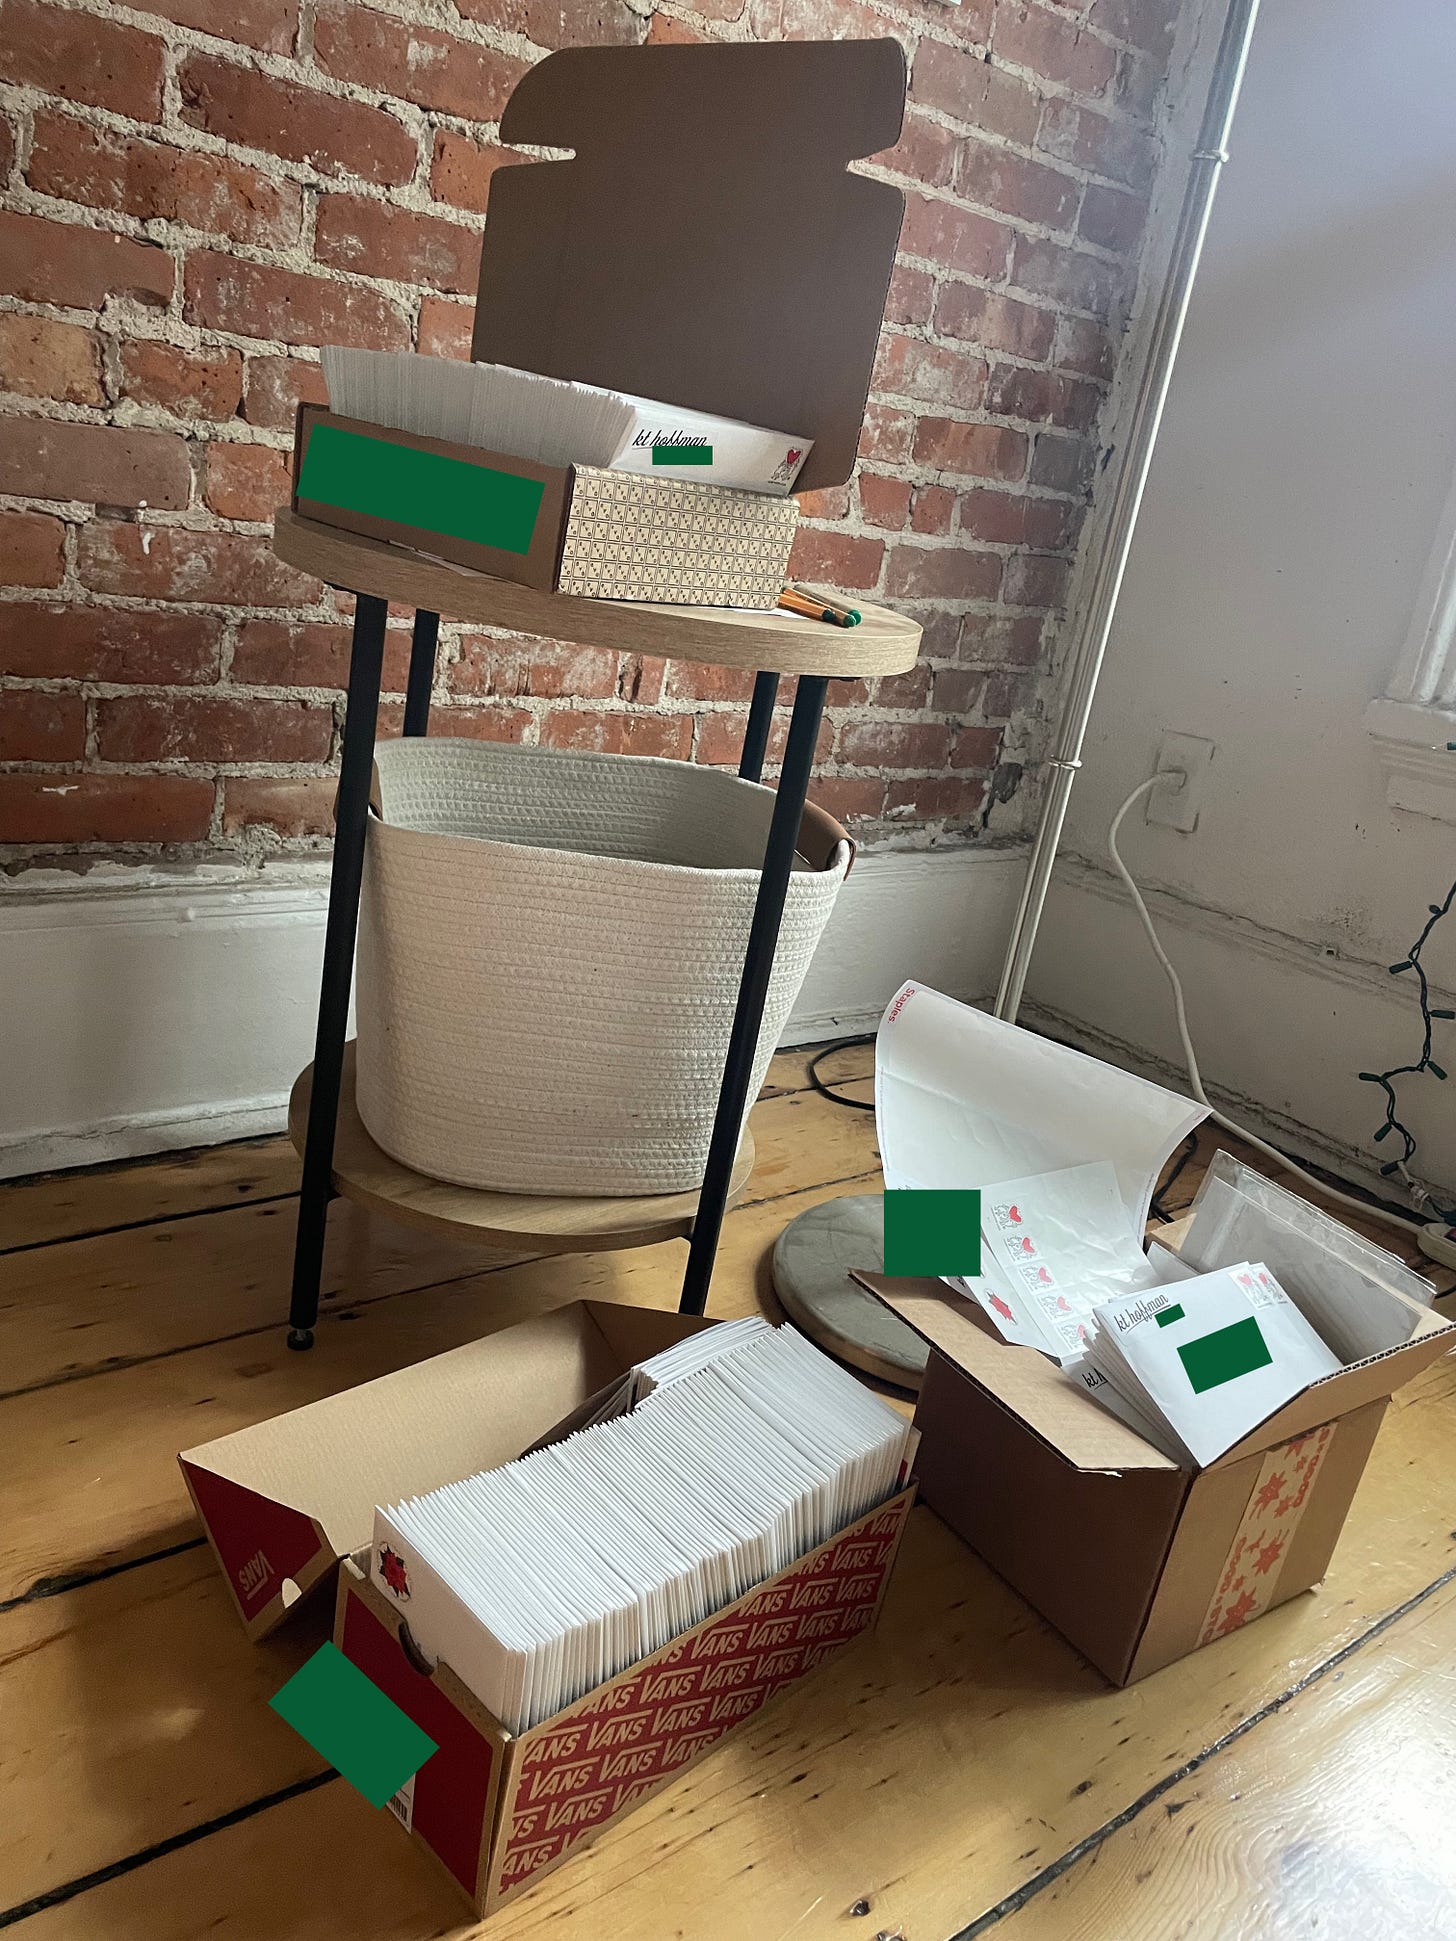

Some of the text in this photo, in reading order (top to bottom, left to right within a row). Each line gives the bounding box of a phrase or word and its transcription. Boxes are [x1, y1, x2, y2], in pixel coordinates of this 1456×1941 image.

[1125, 1294, 1169, 1322] hoffman
[870, 1507, 903, 1536] VAN
[238, 1549, 275, 1600] VANS
[831, 1541, 879, 1571] VANS
[789, 1578, 839, 1610] VANS
[836, 1573, 880, 1602] VANS
[691, 1624, 749, 1660] VANS
[746, 1616, 799, 1649] VANS
[795, 1608, 844, 1640] VANS
[639, 1666, 703, 1704] VANS
[700, 1656, 756, 1692] VANS
[752, 1647, 804, 1681] VANS
[586, 1710, 653, 1751] VANS
[651, 1697, 712, 1736] VANS
[709, 1686, 764, 1722] VANS
[529, 1756, 600, 1800] VANS
[599, 1741, 664, 1783] VANS
[545, 1787, 613, 1831] VANS
[503, 1836, 559, 1876] ANS
